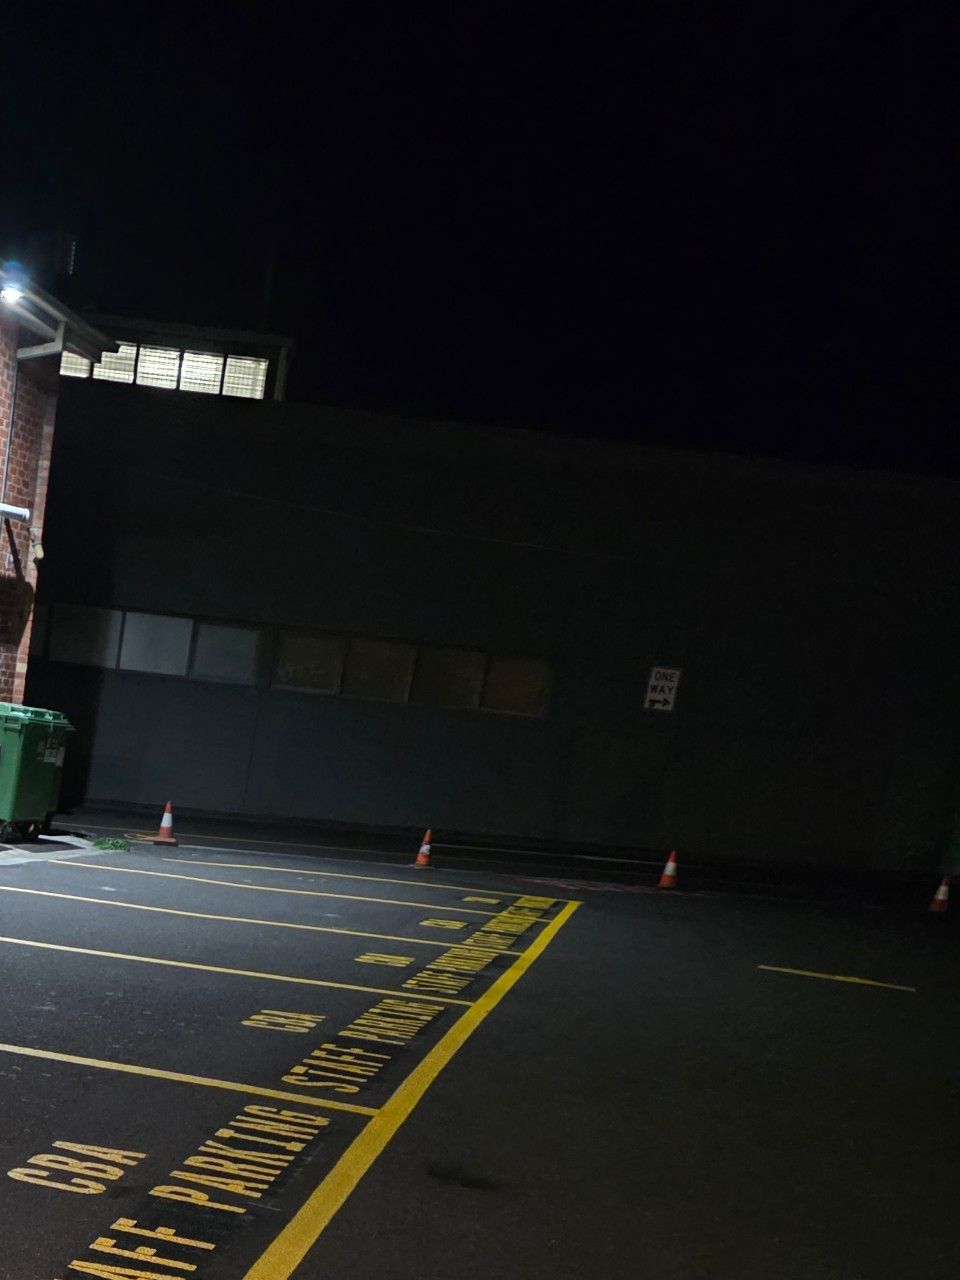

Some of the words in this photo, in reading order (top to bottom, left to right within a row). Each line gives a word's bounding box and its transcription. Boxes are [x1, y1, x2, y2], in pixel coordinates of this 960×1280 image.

[650, 685, 674, 694] WAY
[655, 671, 677, 683] ONE
[281, 1043, 392, 1094] STAFF
[7, 1140, 147, 1195] CBA
[148, 1104, 330, 1214] PARKING
